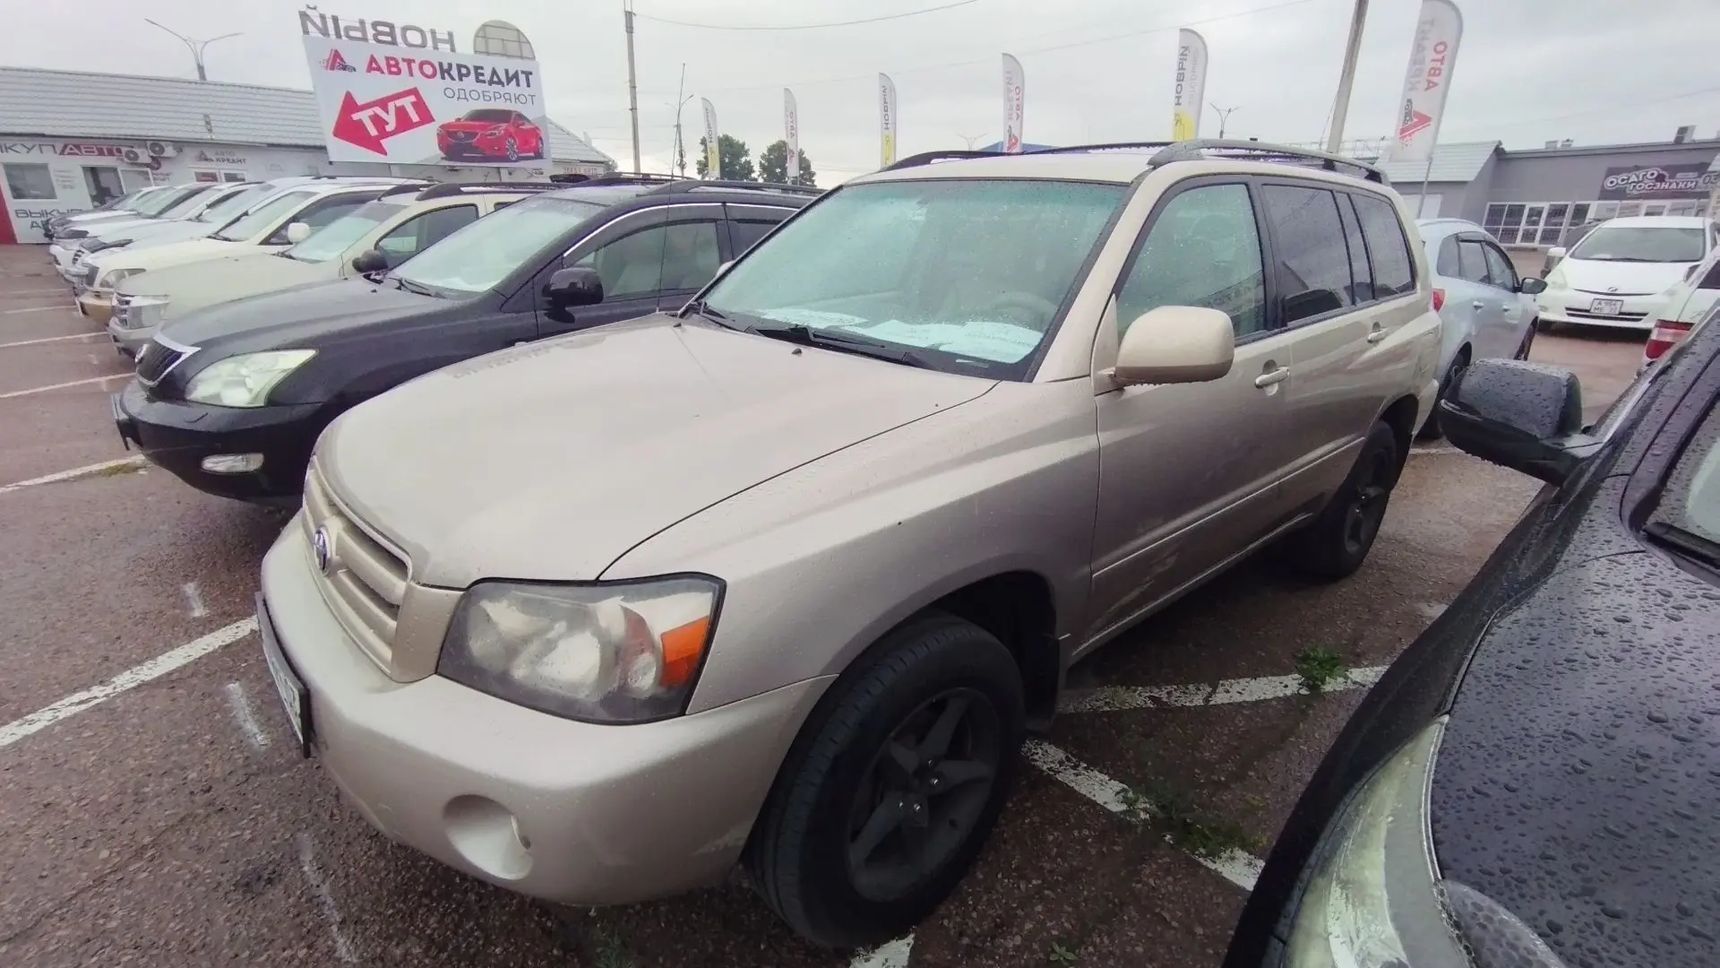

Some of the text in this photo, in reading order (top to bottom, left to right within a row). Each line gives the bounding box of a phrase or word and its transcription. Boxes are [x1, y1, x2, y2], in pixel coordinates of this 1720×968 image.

[365, 54, 534, 88] АВТОКРЕДИТ
[443, 87, 537, 106] ОДОБРЯЮТ
[351, 95, 423, 137] ТУТ
[1606, 169, 1659, 188] ОСАГО
